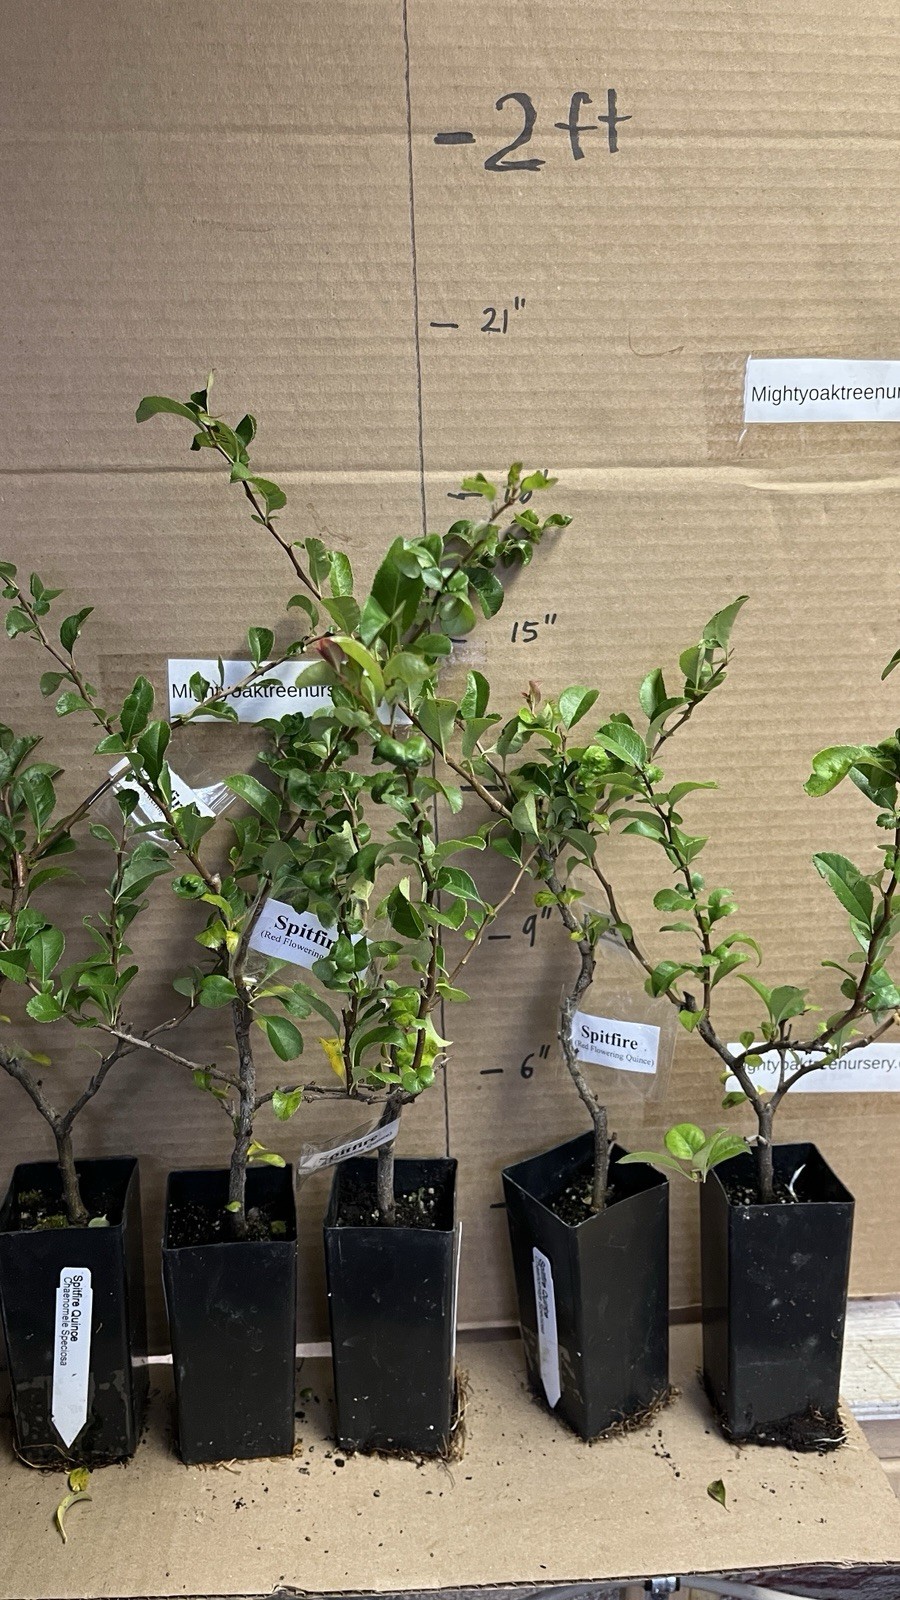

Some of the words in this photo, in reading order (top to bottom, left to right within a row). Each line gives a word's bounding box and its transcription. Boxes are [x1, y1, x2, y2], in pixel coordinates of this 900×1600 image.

[554, 88, 632, 161] ft
[481, 296, 525, 334] 21"
[511, 613, 557, 643] 15"
[260, 929, 282, 943] (Red
[274, 915, 336, 950] Spitfir
[522, 905, 552, 947] 9"
[581, 1024, 638, 1050] Spitfire
[520, 1044, 551, 1079] 6"
[590, 1043, 624, 1061] Flowering
[625, 1053, 655, 1068] Quince)
[62, 1276, 73, 1328] Chaenomele
[72, 1274, 84, 1308] Spitfire
[70, 1309, 82, 1342] Quince
[60, 1329, 71, 1367] Speciosa
